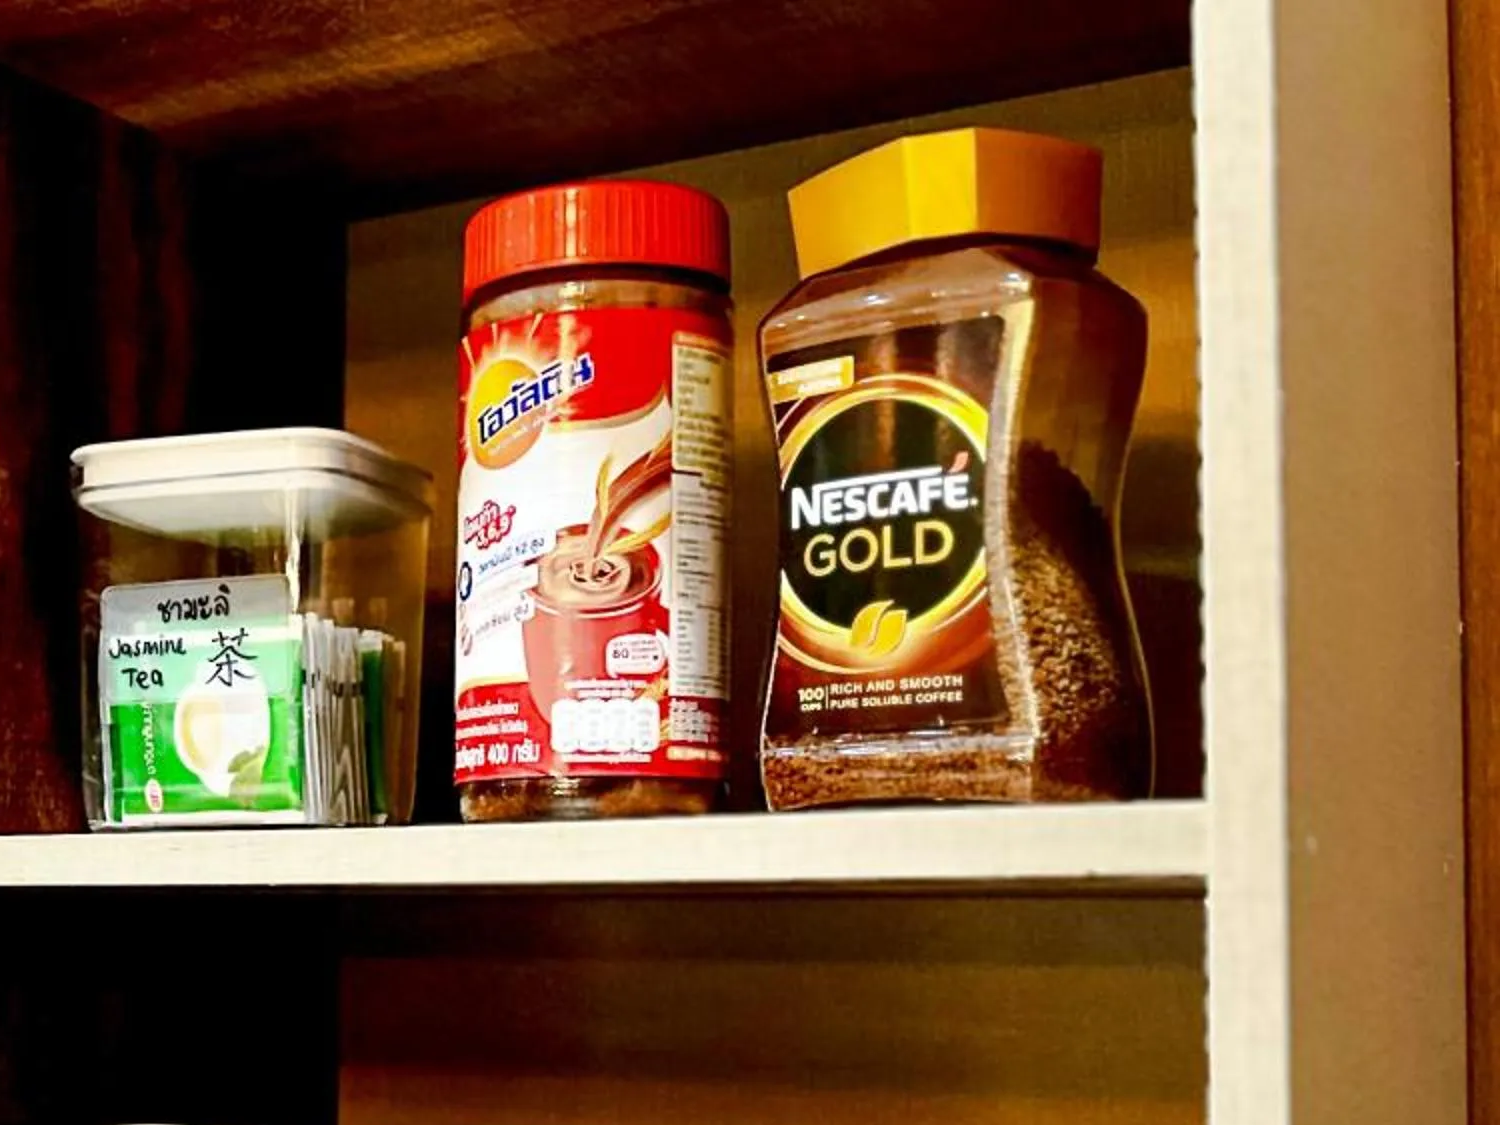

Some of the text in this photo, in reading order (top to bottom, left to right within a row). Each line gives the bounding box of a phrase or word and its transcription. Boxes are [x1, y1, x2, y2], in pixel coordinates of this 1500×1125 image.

[477, 352, 594, 446] โอวัลติน
[803, 519, 954, 577] GOLD
[157, 583, 231, 623] ชามะลิ
[108, 634, 187, 660] Jasmine
[205, 627, 258, 687] 茶
[121, 667, 164, 690] Tea
[830, 675, 964, 695] RICH AND SMOOTH
[797, 687, 825, 702] 100
[830, 690, 964, 709] PURE SOLUBLE COFFEE
